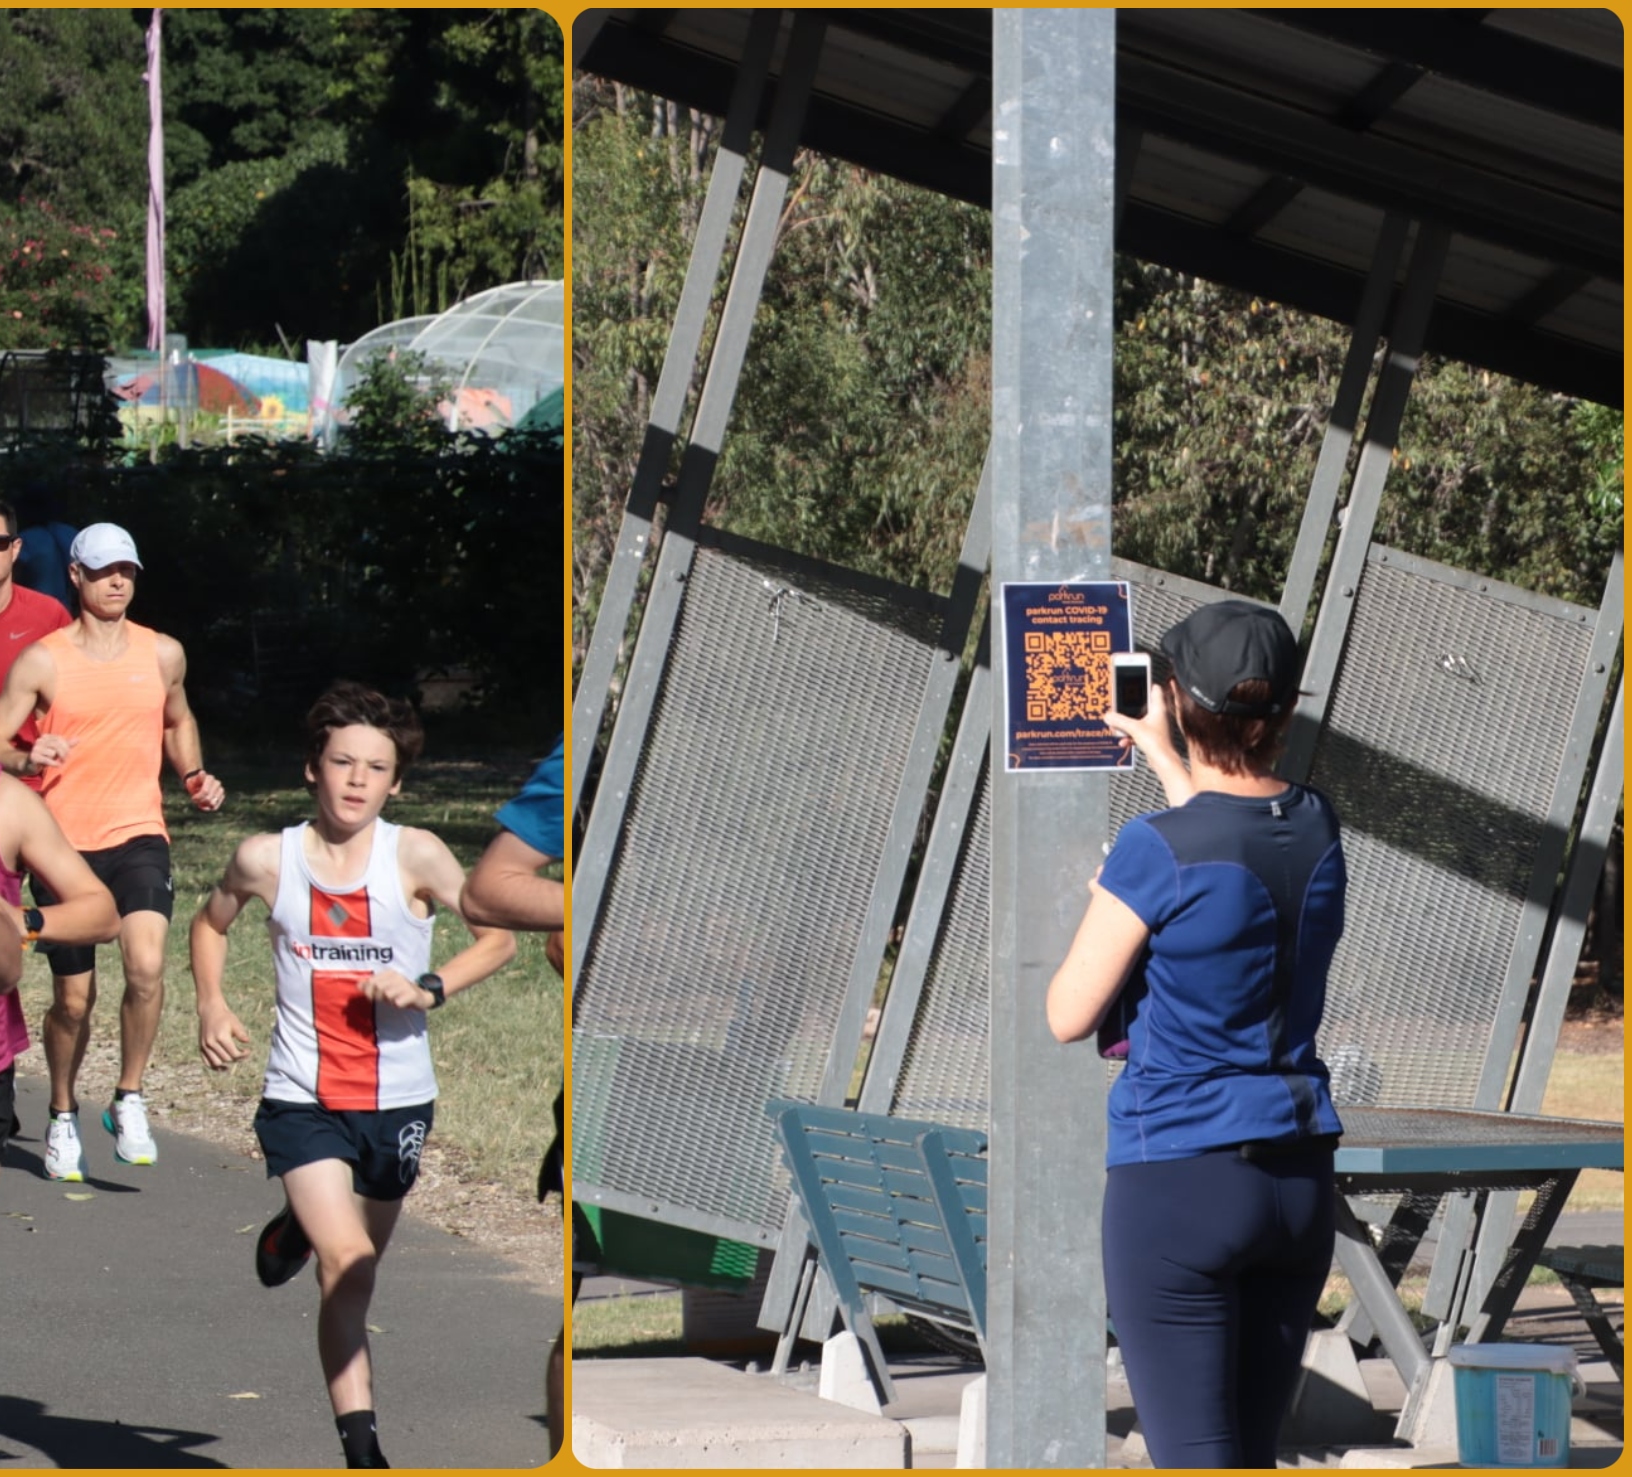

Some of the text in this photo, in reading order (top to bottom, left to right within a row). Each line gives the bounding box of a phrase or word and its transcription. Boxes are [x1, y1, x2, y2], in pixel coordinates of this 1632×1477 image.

[1049, 592, 1085, 602] parkrun
[1026, 605, 1108, 617] parkrun COVID-19
[1031, 615, 1103, 625] contact tracing
[291, 941, 394, 964] intraining
